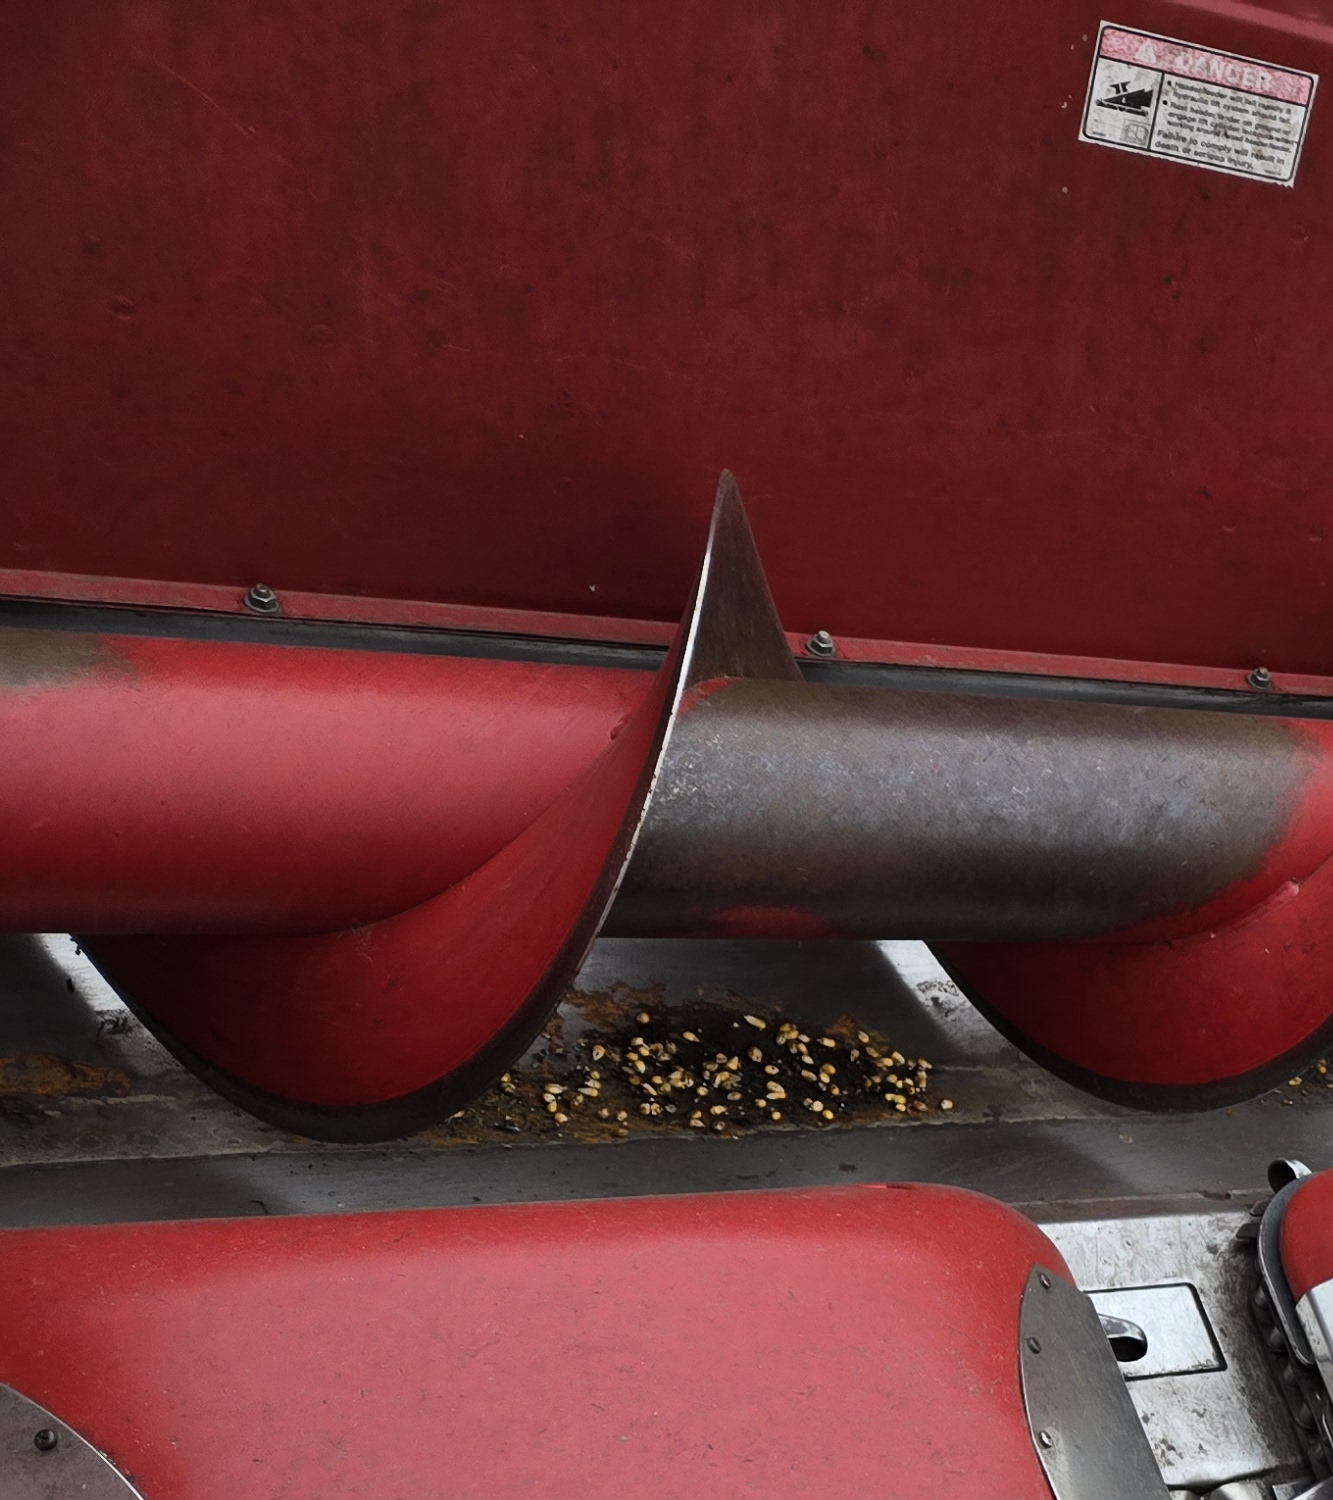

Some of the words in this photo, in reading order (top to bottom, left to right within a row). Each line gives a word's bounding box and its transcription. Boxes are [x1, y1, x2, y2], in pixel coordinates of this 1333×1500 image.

[1175, 50, 1273, 91] DANGER
[1222, 102, 1249, 115] system
[1166, 119, 1194, 132] working
[1154, 140, 1178, 152] death
[1181, 146, 1190, 155] or
[1193, 149, 1225, 163] serious
[1157, 129, 1187, 143] Failure
[1189, 136, 1198, 146] to
[1200, 139, 1232, 153] comply
[1233, 146, 1248, 157] will
[1250, 150, 1274, 163] result
[1276, 156, 1284, 165] in
